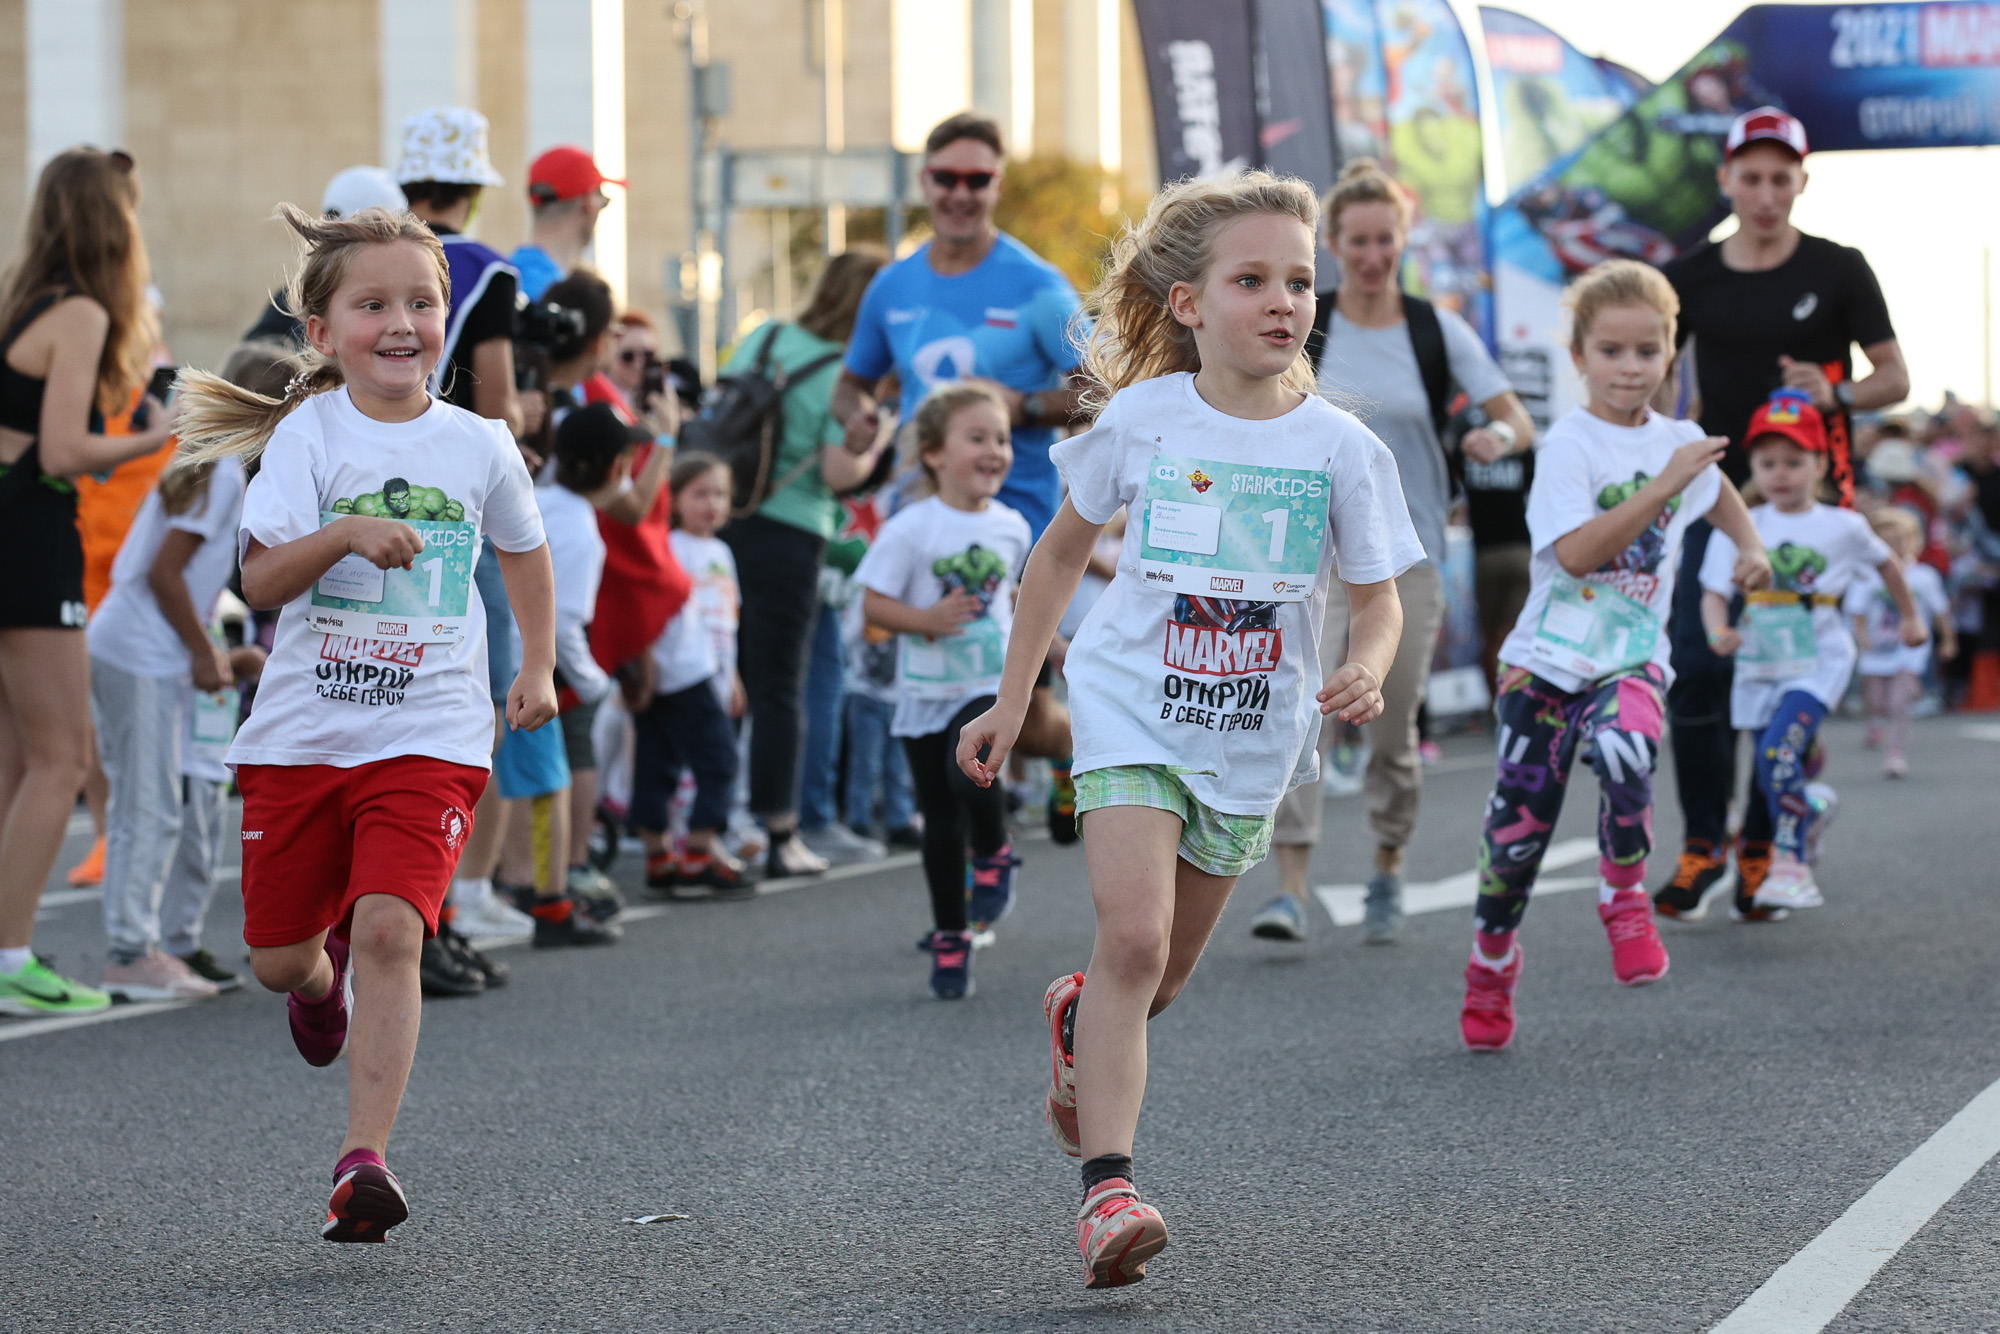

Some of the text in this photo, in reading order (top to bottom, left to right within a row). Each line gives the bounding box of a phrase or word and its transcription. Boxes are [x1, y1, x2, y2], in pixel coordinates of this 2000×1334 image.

[1160, 468, 1175, 478] 0-6
[1230, 473, 1323, 498] STARKIDS
[1261, 507, 1289, 562] 1
[421, 557, 443, 607] 1
[1211, 577, 1243, 592] MARVEL
[377, 622, 407, 636] MARVEL
[1165, 622, 1277, 674] MARVEL
[315, 660, 414, 690] ОТКРОЙ
[321, 683, 358, 703] СЕБЕ
[361, 688, 405, 706] ГЕРОЯ
[1164, 673, 1270, 711] ОТКРОЙ
[1160, 702, 1264, 732] В СЕБЕ ГЕРОЯ
